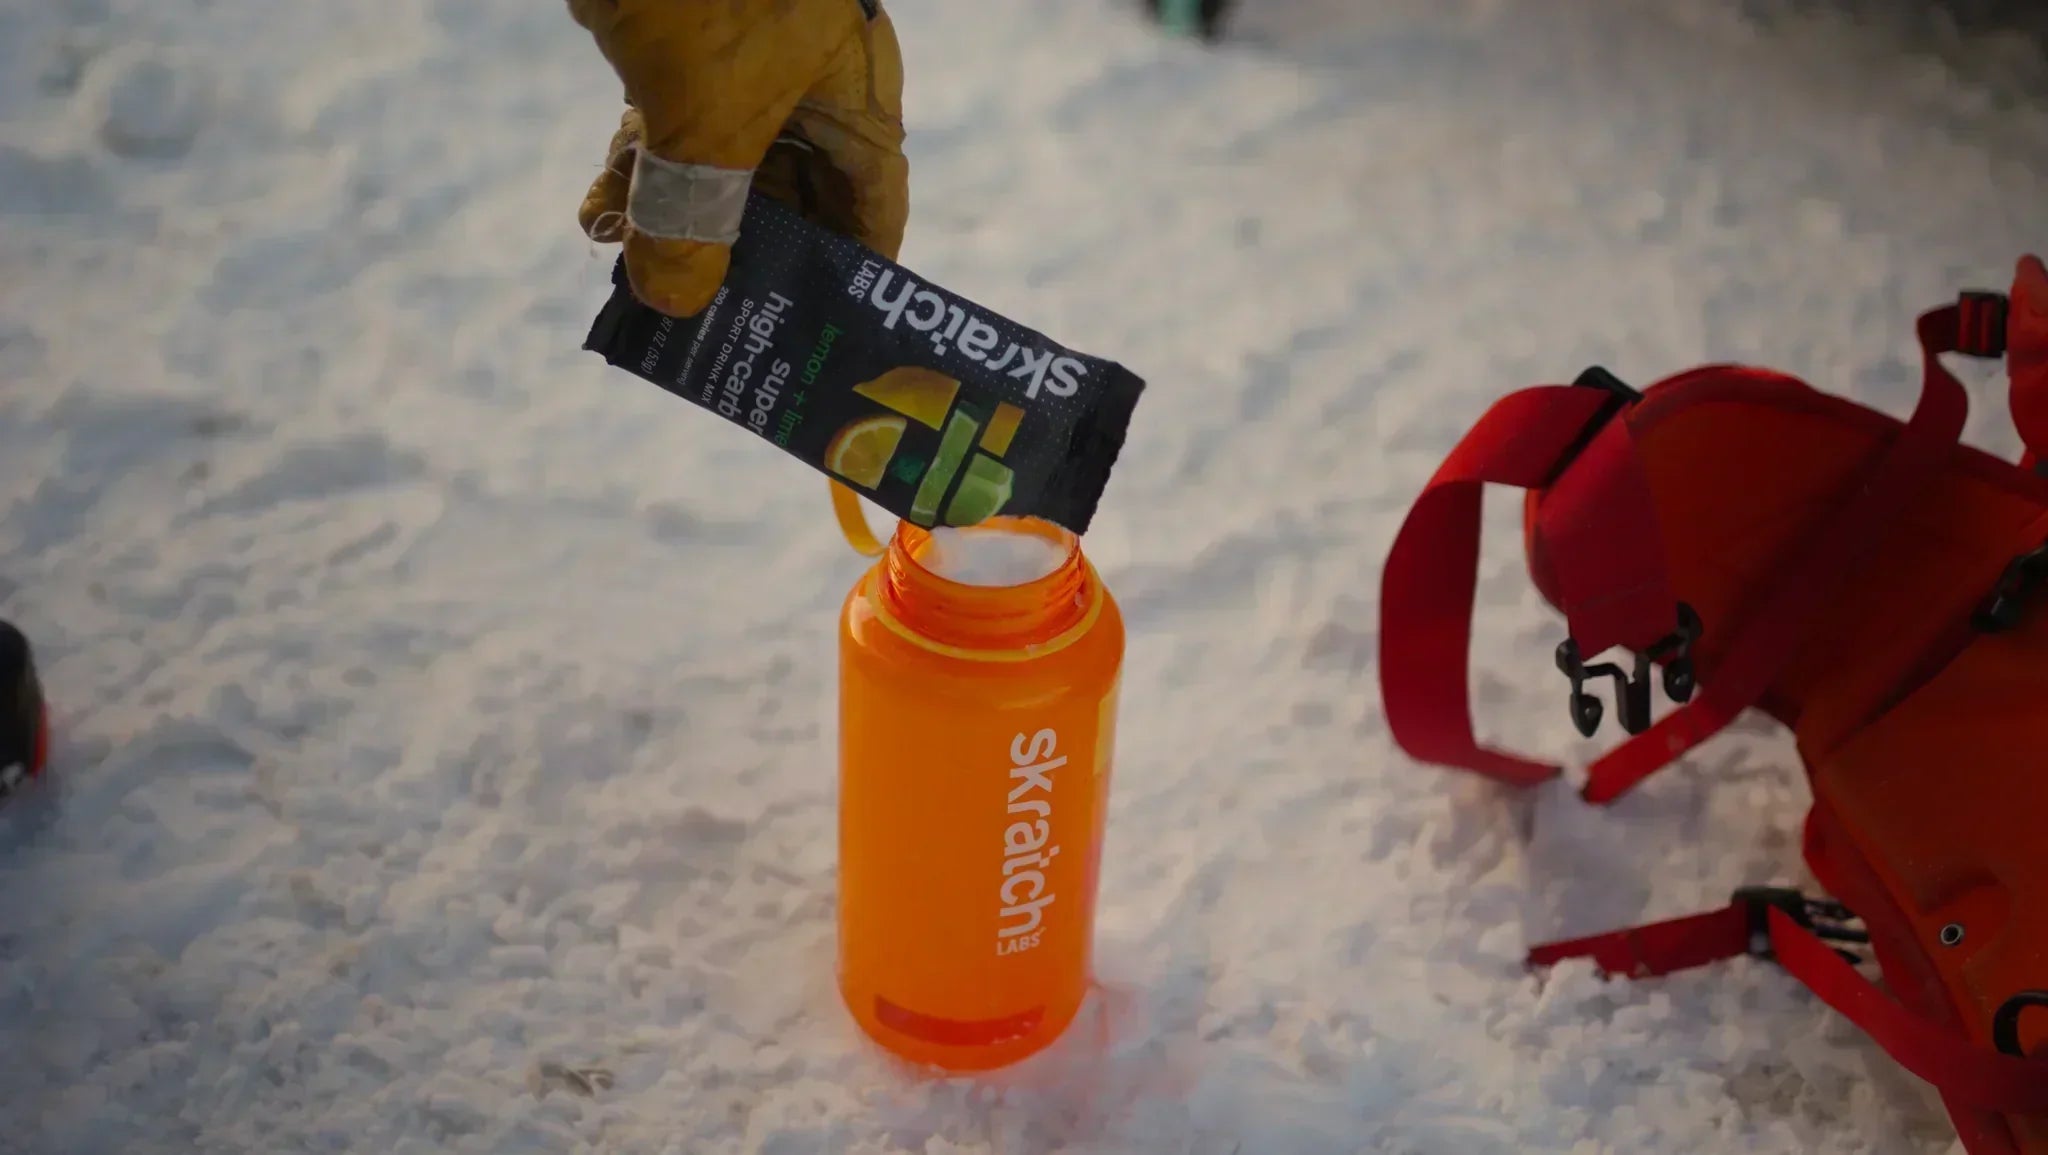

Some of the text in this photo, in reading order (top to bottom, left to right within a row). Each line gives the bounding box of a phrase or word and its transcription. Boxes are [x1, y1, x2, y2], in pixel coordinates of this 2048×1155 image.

[714, 285, 729, 305] 200
[848, 259, 881, 299] LABS
[697, 305, 718, 341] calories
[700, 298, 754, 404] SPORT DRINK MIX
[801, 323, 845, 385] lemon
[871, 268, 1088, 399] skratch
[717, 291, 794, 418] high-carb
[748, 358, 791, 435] super
[774, 409, 803, 447] lime
[998, 727, 1067, 938] skratch
[996, 931, 1042, 956] LABS
